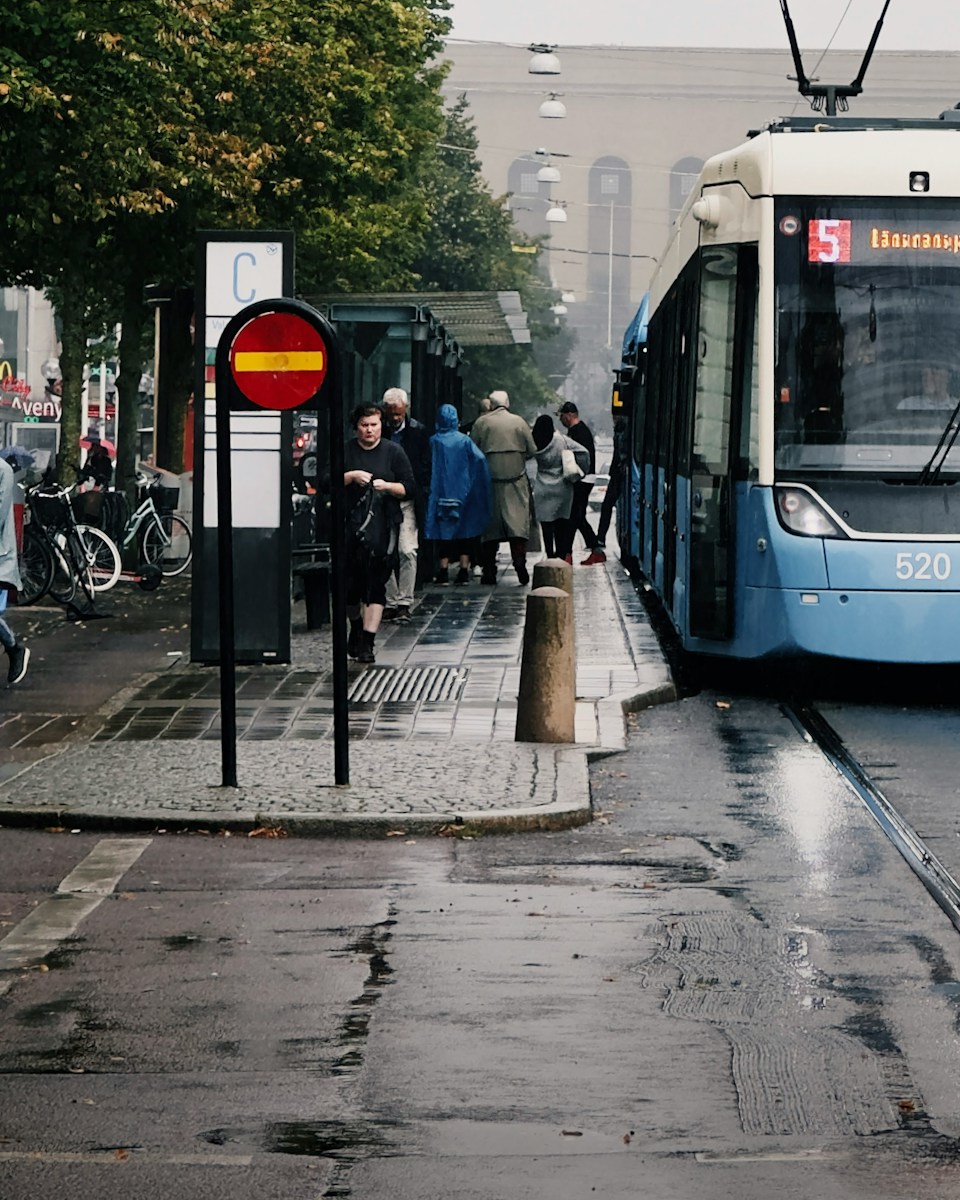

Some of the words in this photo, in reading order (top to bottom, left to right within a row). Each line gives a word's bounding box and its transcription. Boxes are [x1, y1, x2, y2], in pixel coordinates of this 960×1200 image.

[818, 219, 840, 262] 5
[232, 252, 257, 304] C
[896, 552, 951, 580] 520
